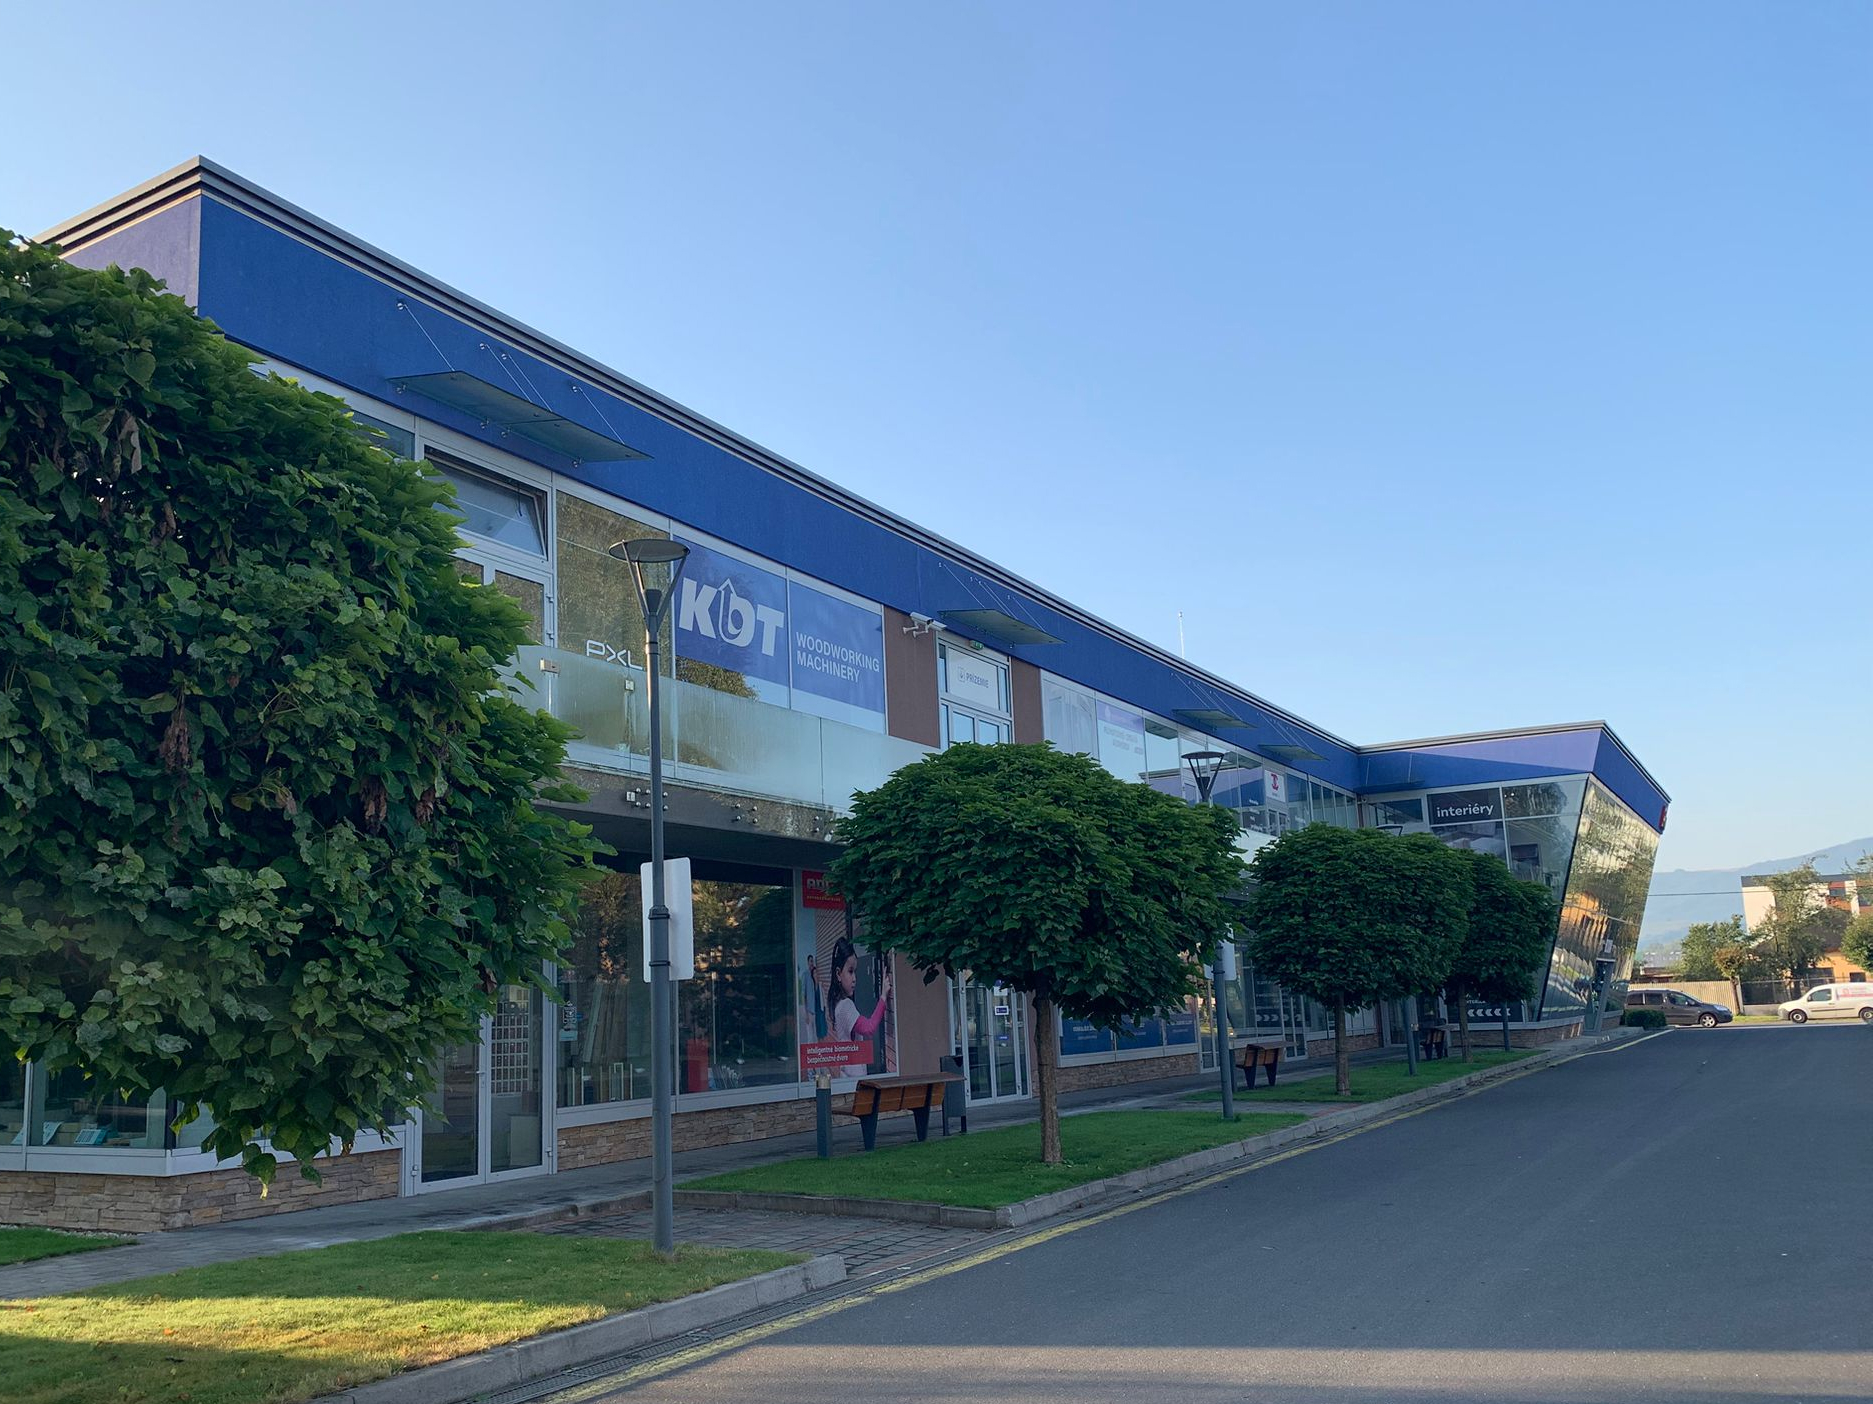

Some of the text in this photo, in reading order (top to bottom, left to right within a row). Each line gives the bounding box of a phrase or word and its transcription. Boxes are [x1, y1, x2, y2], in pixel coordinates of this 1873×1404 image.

[679, 577, 785, 657] KOT
[587, 640, 643, 670] PXL
[796, 631, 880, 673] WOODWORKING
[797, 650, 860, 683] MACHINERY
[1436, 802, 1494, 818] interiéry
